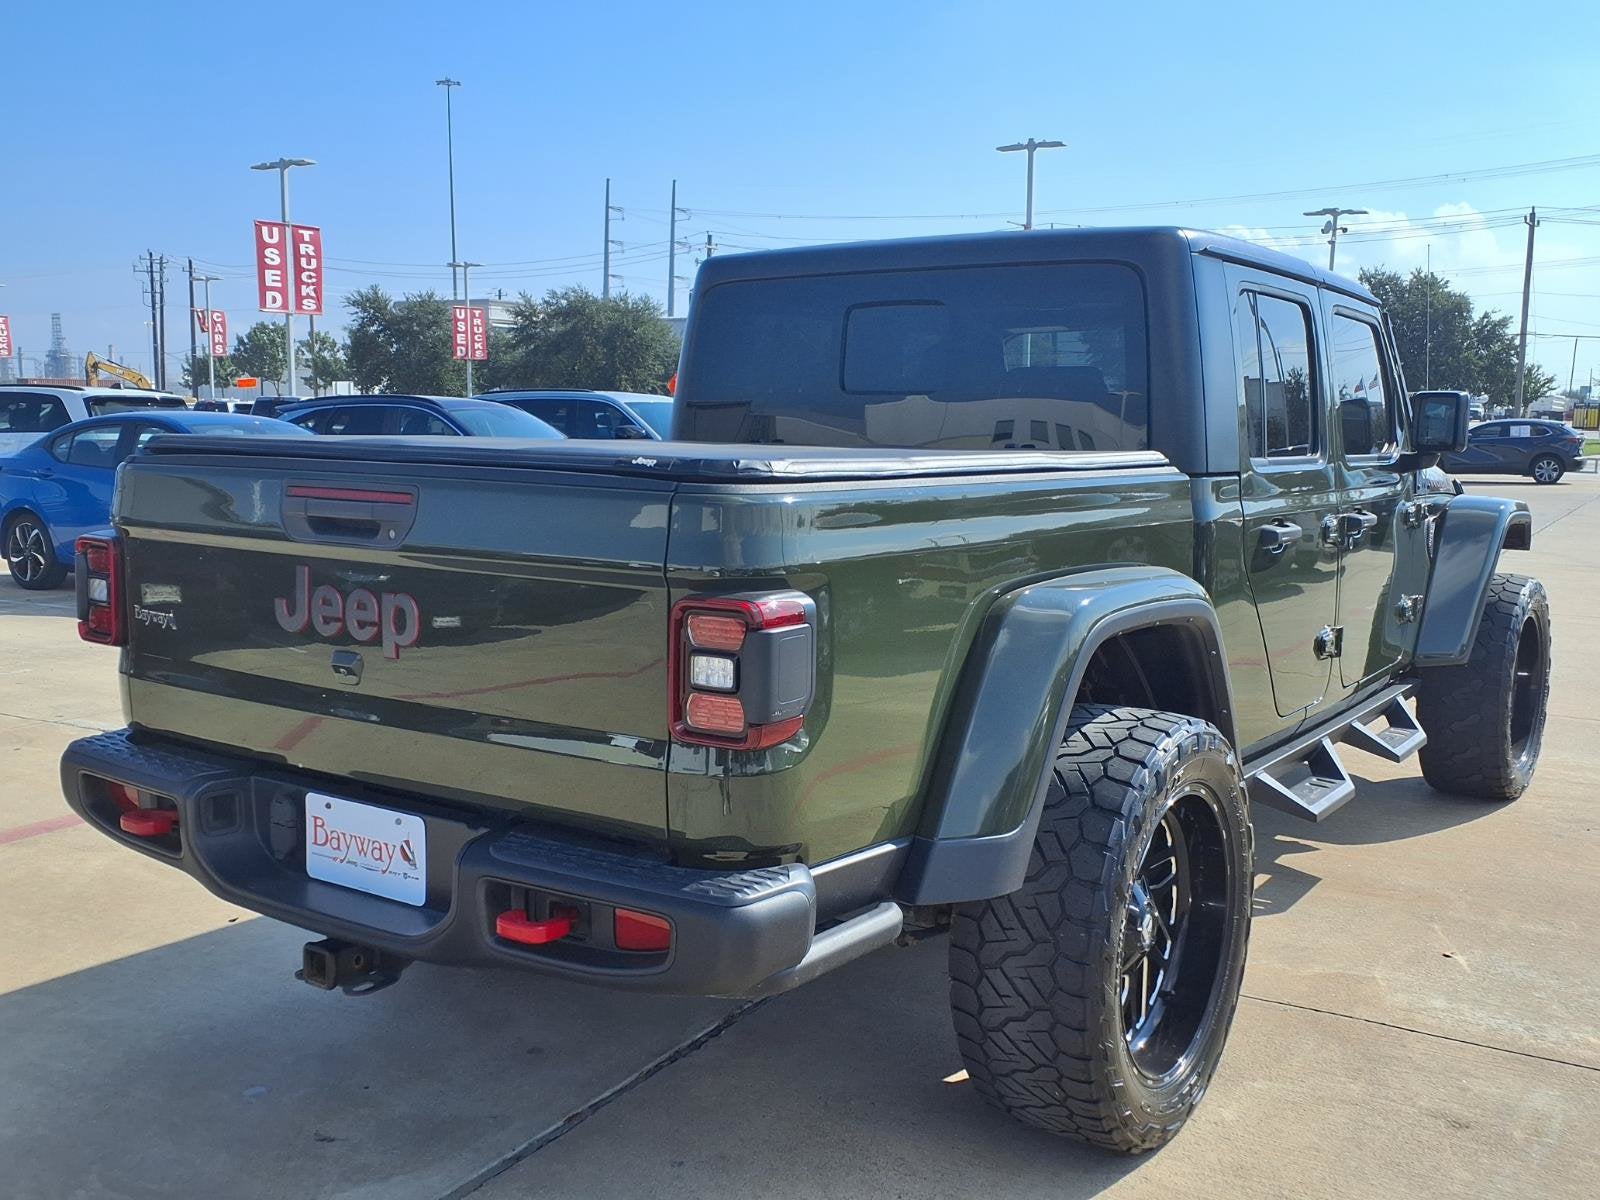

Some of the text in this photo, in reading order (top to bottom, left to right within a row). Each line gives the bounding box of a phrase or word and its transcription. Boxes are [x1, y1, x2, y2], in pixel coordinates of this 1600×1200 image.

[261, 226, 282, 308] USED
[298, 229, 317, 310] TRUCKS
[212, 312, 223, 354] CARS
[456, 308, 466, 357] USED
[473, 310, 483, 357] TRUCKS
[133, 604, 168, 629] Bayway
[274, 565, 420, 660] Jeep
[312, 815, 397, 875] Bayway
